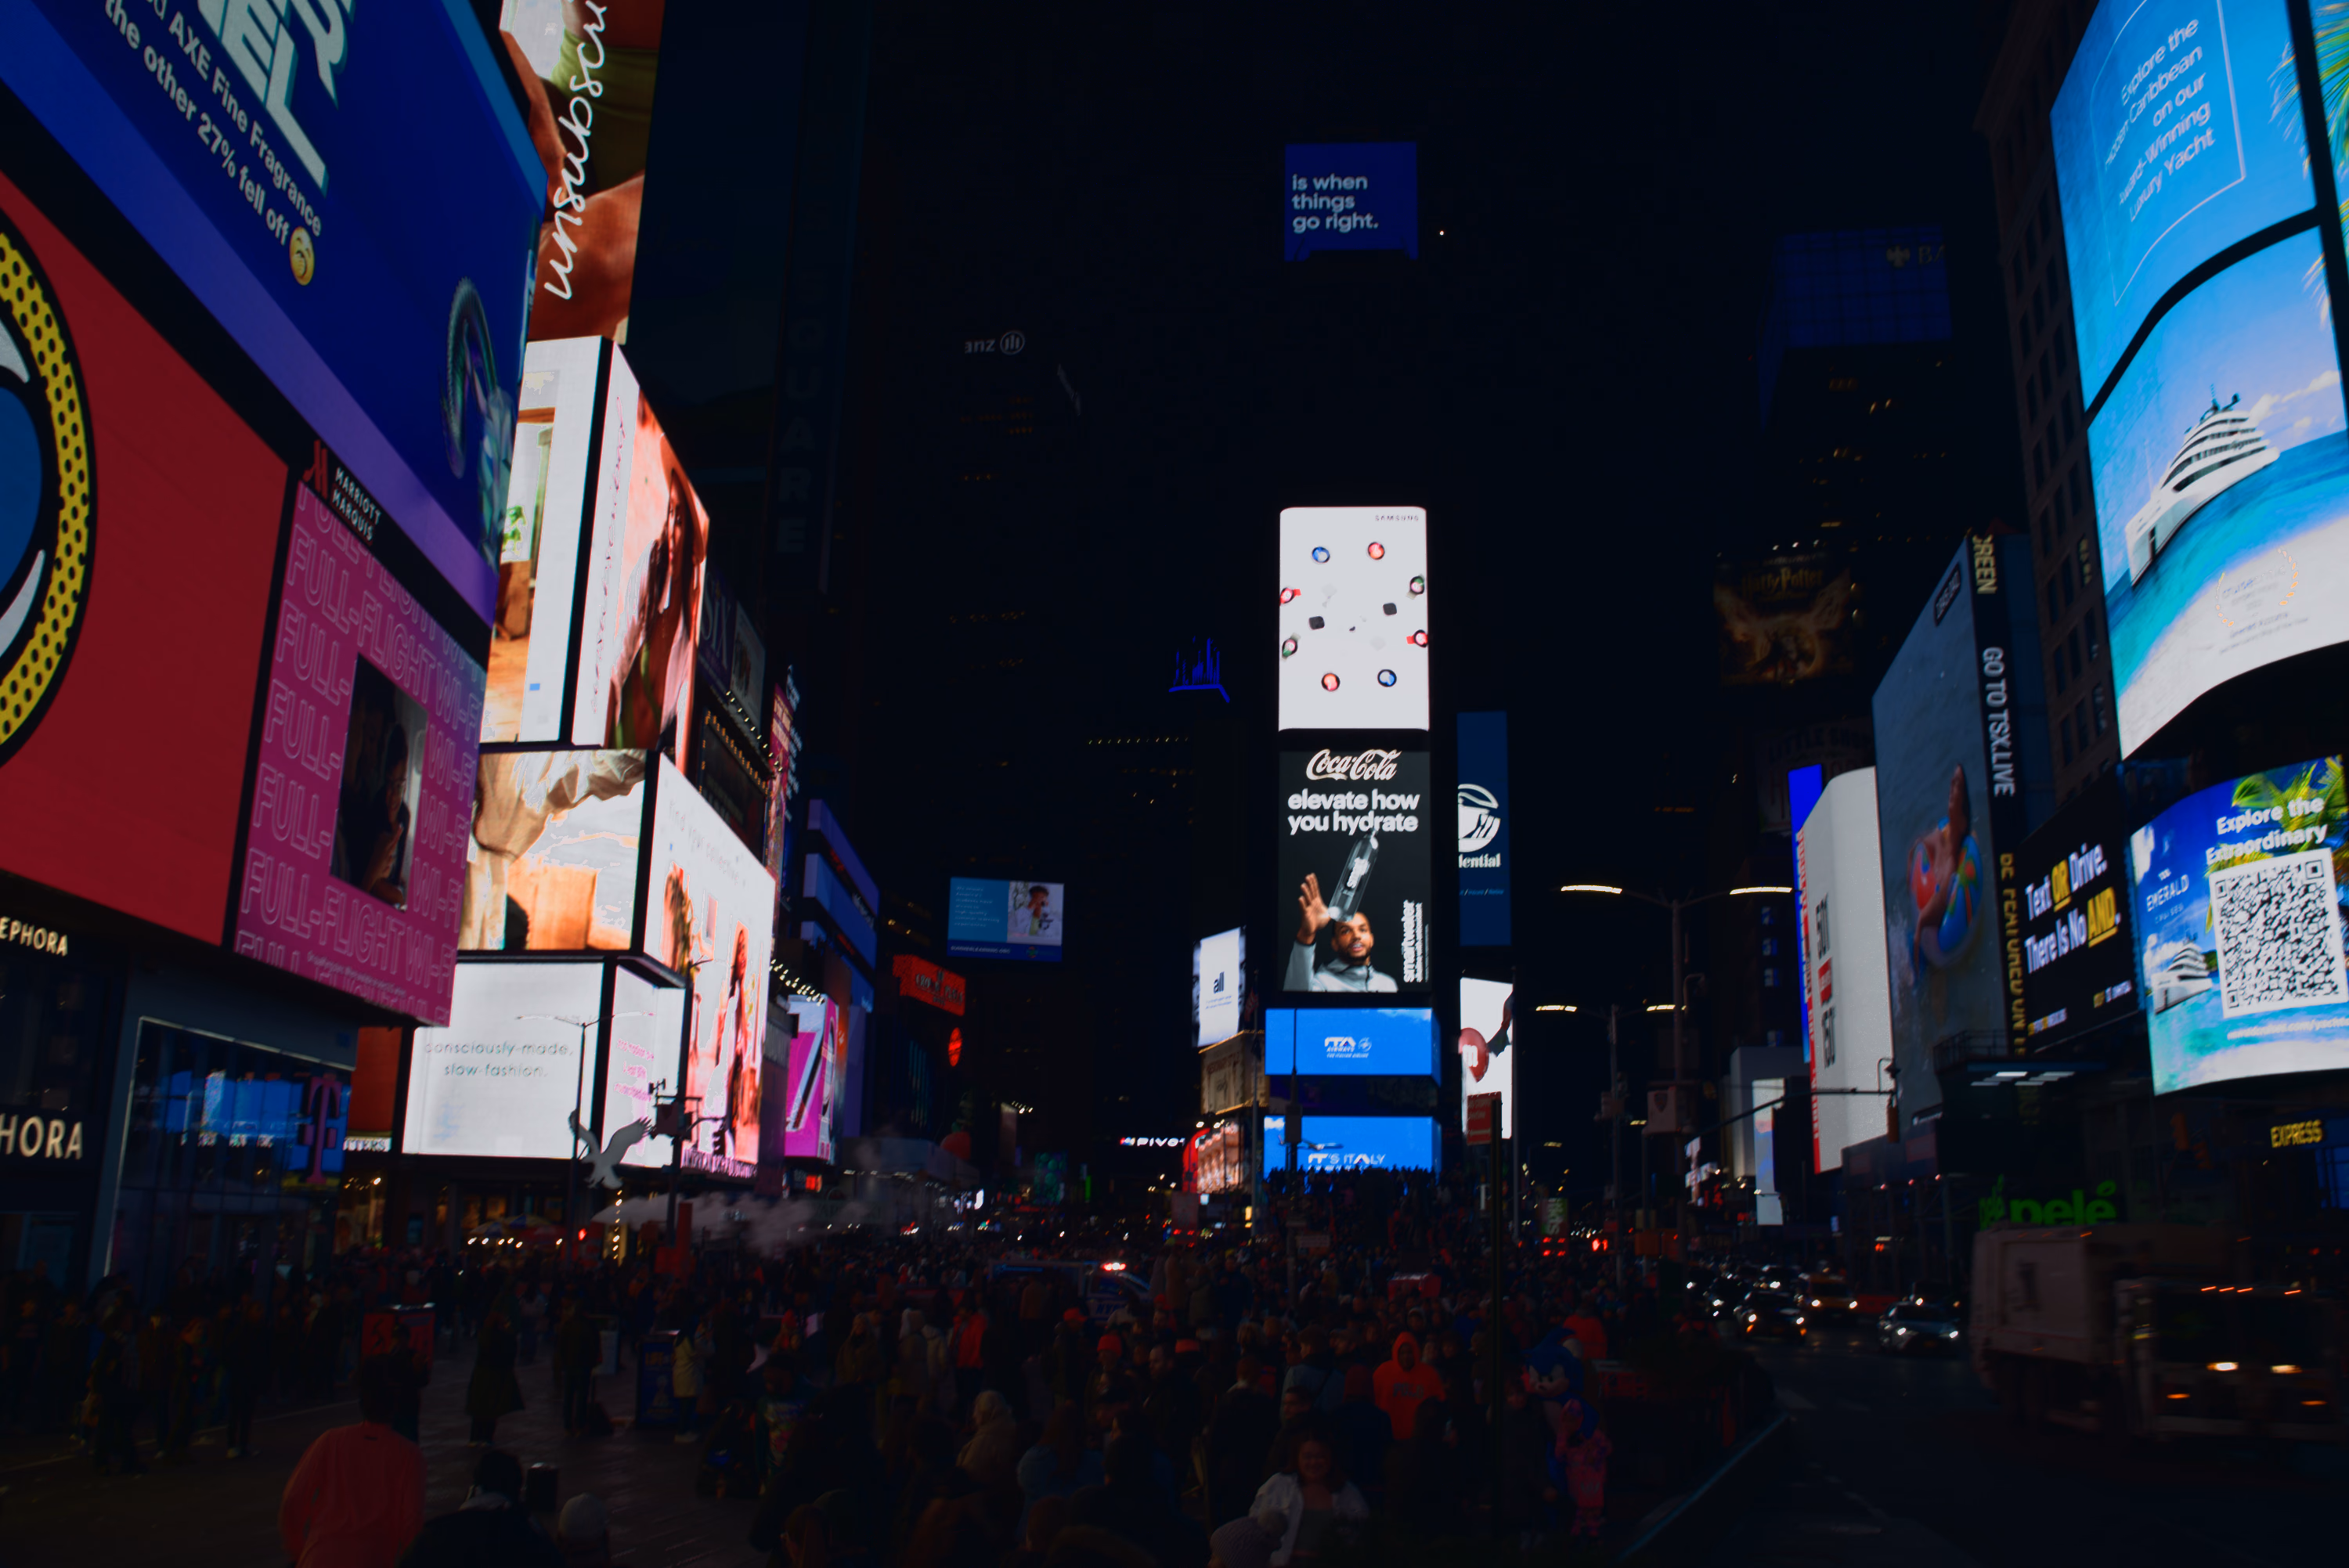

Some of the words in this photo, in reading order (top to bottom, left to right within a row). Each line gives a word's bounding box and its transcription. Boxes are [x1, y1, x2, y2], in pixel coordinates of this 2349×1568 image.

[2121, 45, 2167, 107] Explore
[2167, 19, 2199, 52] the
[2129, 45, 2203, 124] Caribbean
[2153, 99, 2174, 127] on
[2174, 72, 2206, 107] our
[168, 10, 212, 81] AXE
[211, 66, 248, 133] Fine
[250, 120, 323, 237] Fragrance
[143, 45, 197, 121] other
[197, 112, 236, 178] 27%
[239, 165, 265, 216] fell
[266, 208, 290, 246] off
[1292, 172, 1308, 192] is
[1312, 172, 1369, 191] when
[2129, 170, 2163, 223] Luxury
[2163, 127, 2216, 176] Yacht
[1291, 192, 1356, 214] things
[1292, 215, 1322, 235] go
[1325, 211, 1380, 235] right.
[335, 467, 382, 525] MARRIOTT
[332, 488, 374, 542] MARQUIS
[1740, 570, 1781, 601] Harry
[1780, 565, 1824, 593] Potter
[1983, 647, 2004, 677] GO
[1986, 678, 2008, 708] TO
[1305, 748, 1402, 780] Coca-Cola
[1287, 788, 1369, 810] elevate
[1371, 788, 1420, 810] how
[2216, 806, 2284, 835] Explore
[2287, 796, 2325, 818] the
[1287, 814, 1330, 836] you
[1333, 809, 1419, 836] hydrate
[2206, 824, 2329, 866] Extraordinary
[2025, 874, 2052, 921] Text
[2051, 860, 2072, 907] OR
[2068, 842, 2108, 892] Drive.
[2146, 874, 2190, 912] EMERALD
[2024, 935, 2058, 974] There
[2055, 918, 2069, 957] Is
[2068, 907, 2087, 950] No
[2087, 886, 2121, 941] AND.
[1213, 971, 1225, 994] all
[425, 1040, 575, 1057] consciously-made,
[1325, 1036, 1357, 1047] ITA
[444, 1062, 549, 1078] slow-fashion.
[2270, 1119, 2323, 1148] EXPRESS
[1308, 1153, 1340, 1166] IT'S
[1343, 1153, 1386, 1166] ITALY
